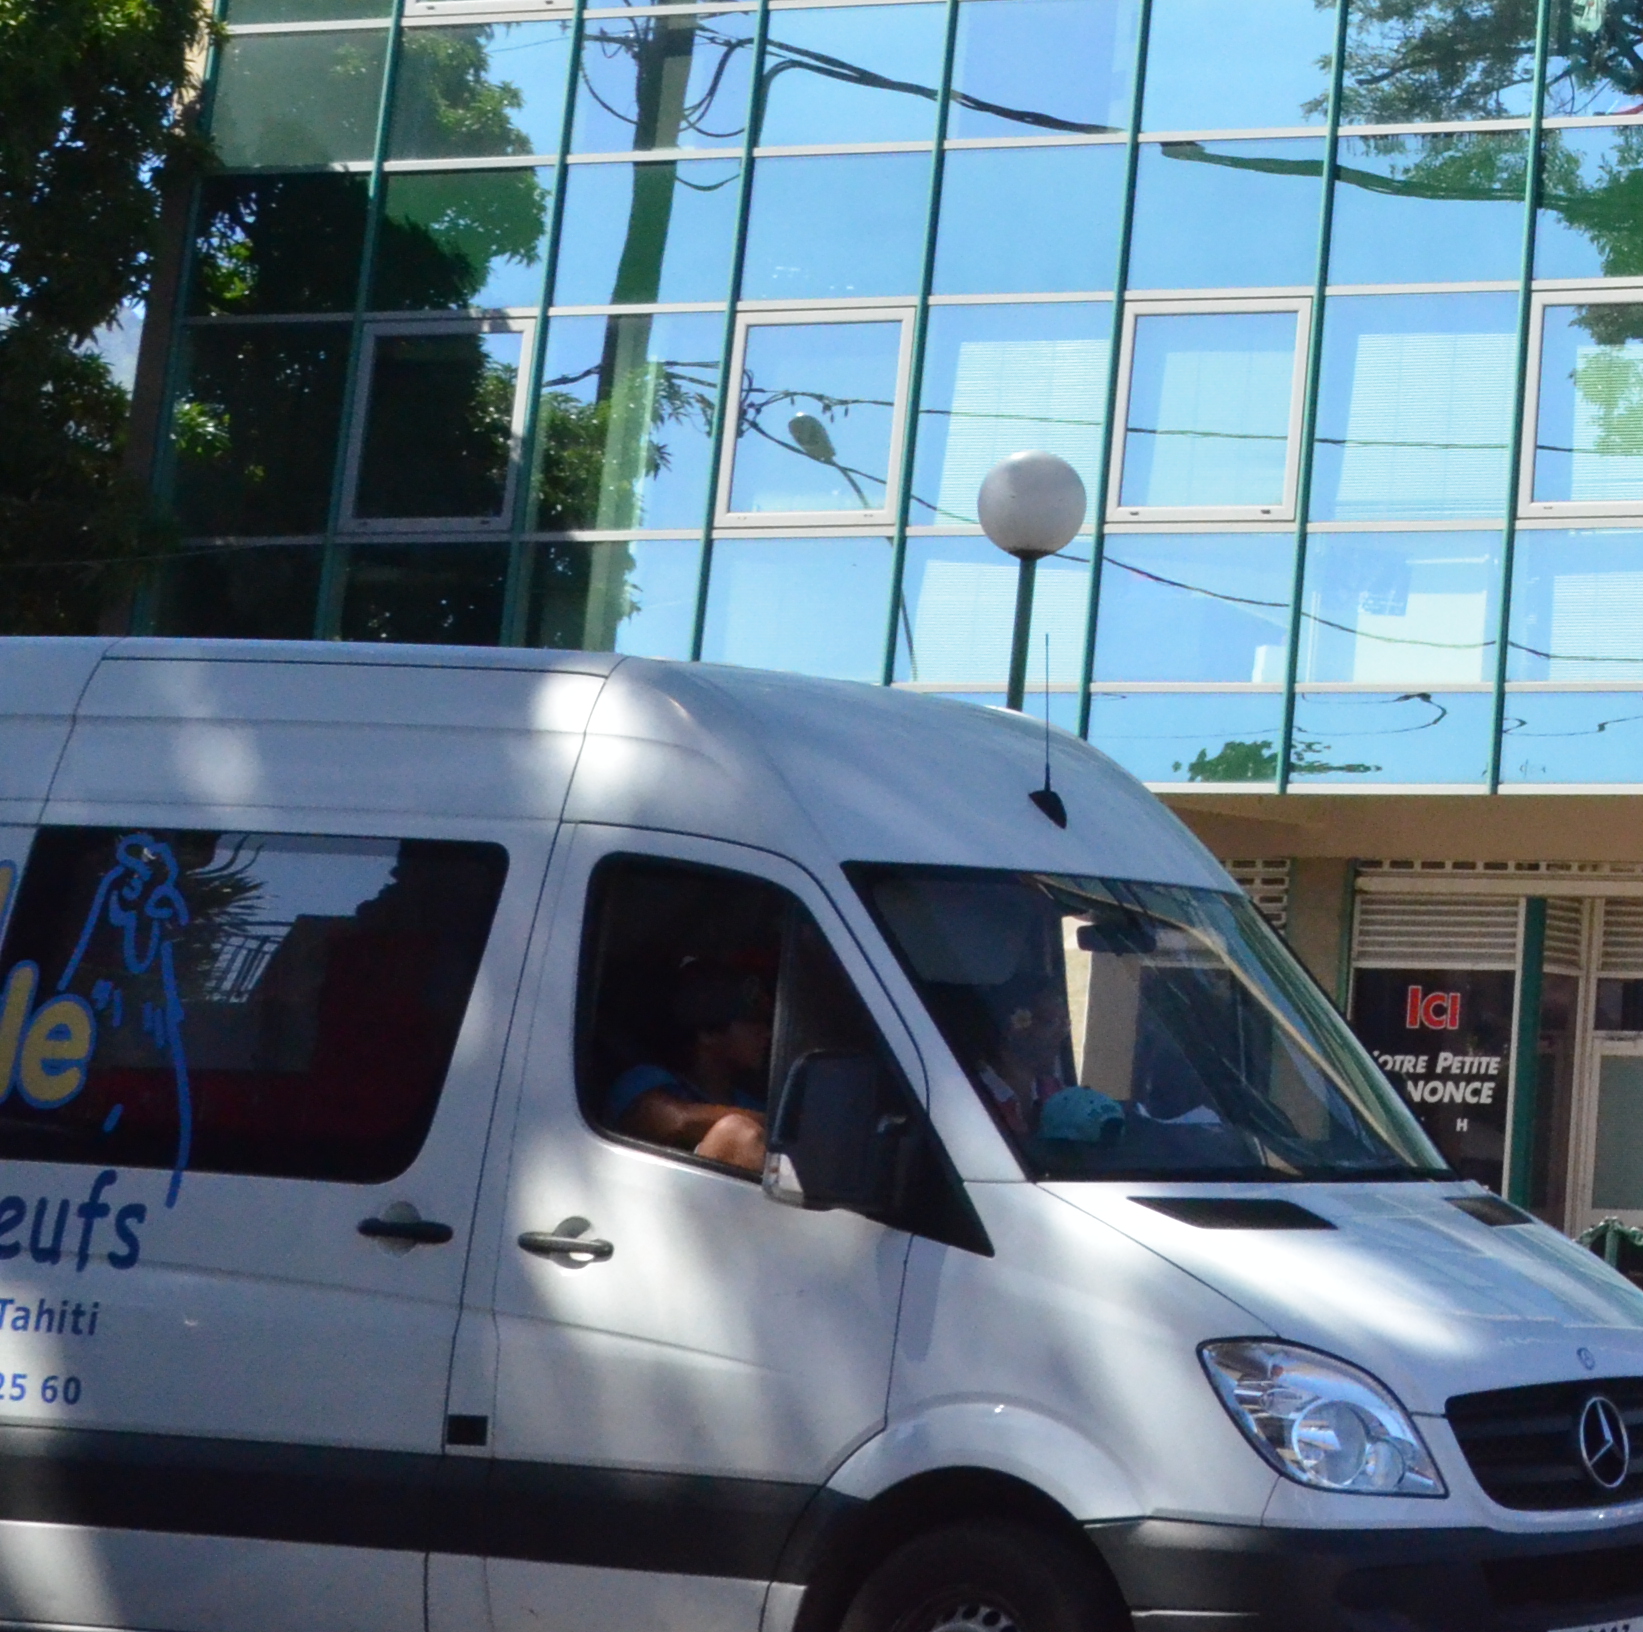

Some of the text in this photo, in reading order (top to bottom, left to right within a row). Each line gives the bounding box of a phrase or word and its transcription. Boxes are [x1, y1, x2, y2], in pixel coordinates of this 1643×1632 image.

[1373, 1050, 1501, 1075] OTRE PETITE
[41, 1375, 82, 1405] 60
